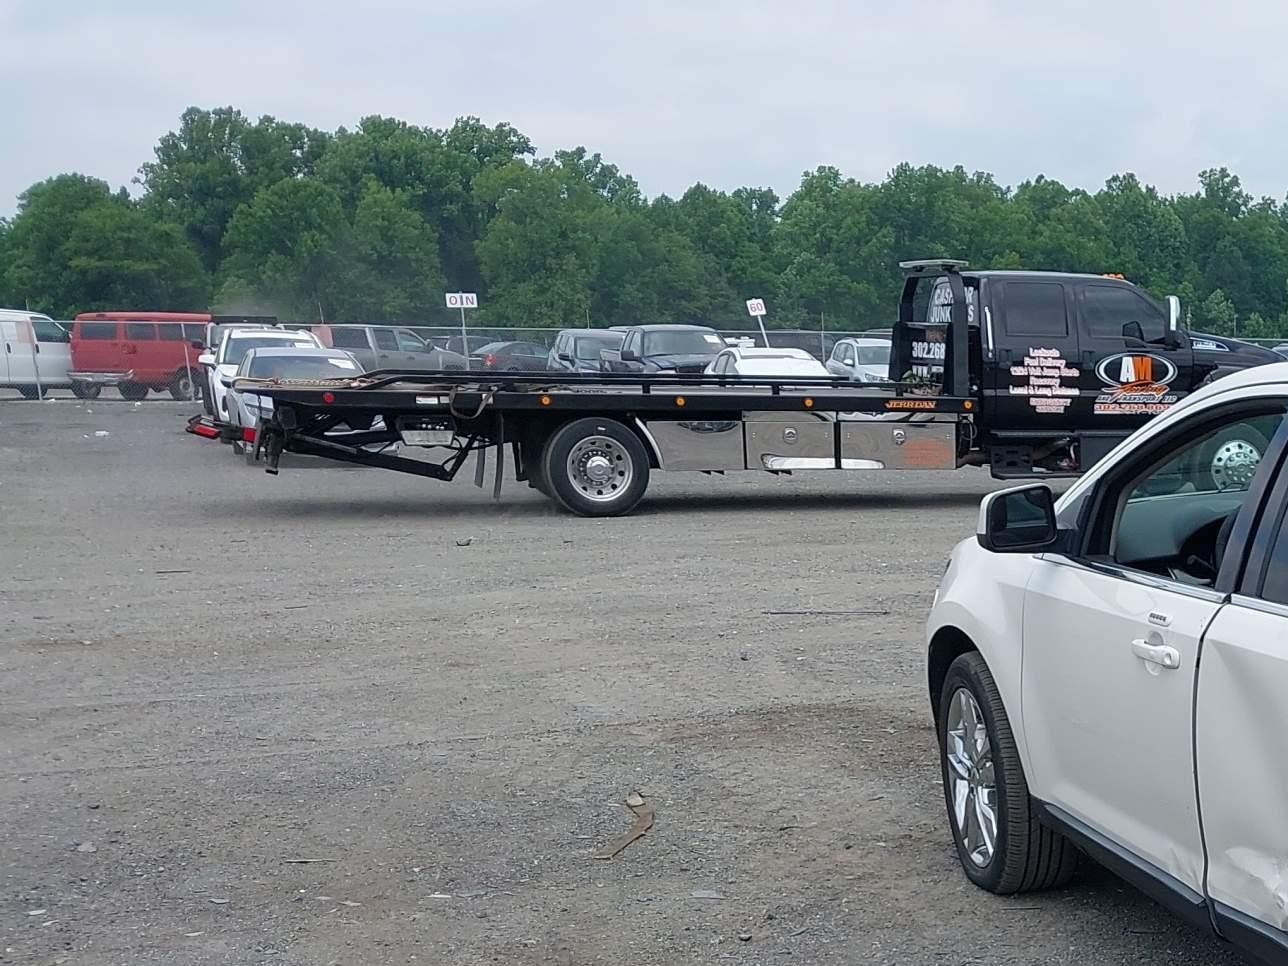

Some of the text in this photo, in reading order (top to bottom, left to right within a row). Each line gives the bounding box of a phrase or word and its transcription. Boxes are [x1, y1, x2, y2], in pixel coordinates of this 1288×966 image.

[750, 303, 763, 312] 60
[931, 306, 951, 322] JUNK
[1120, 356, 1152, 382] AM
